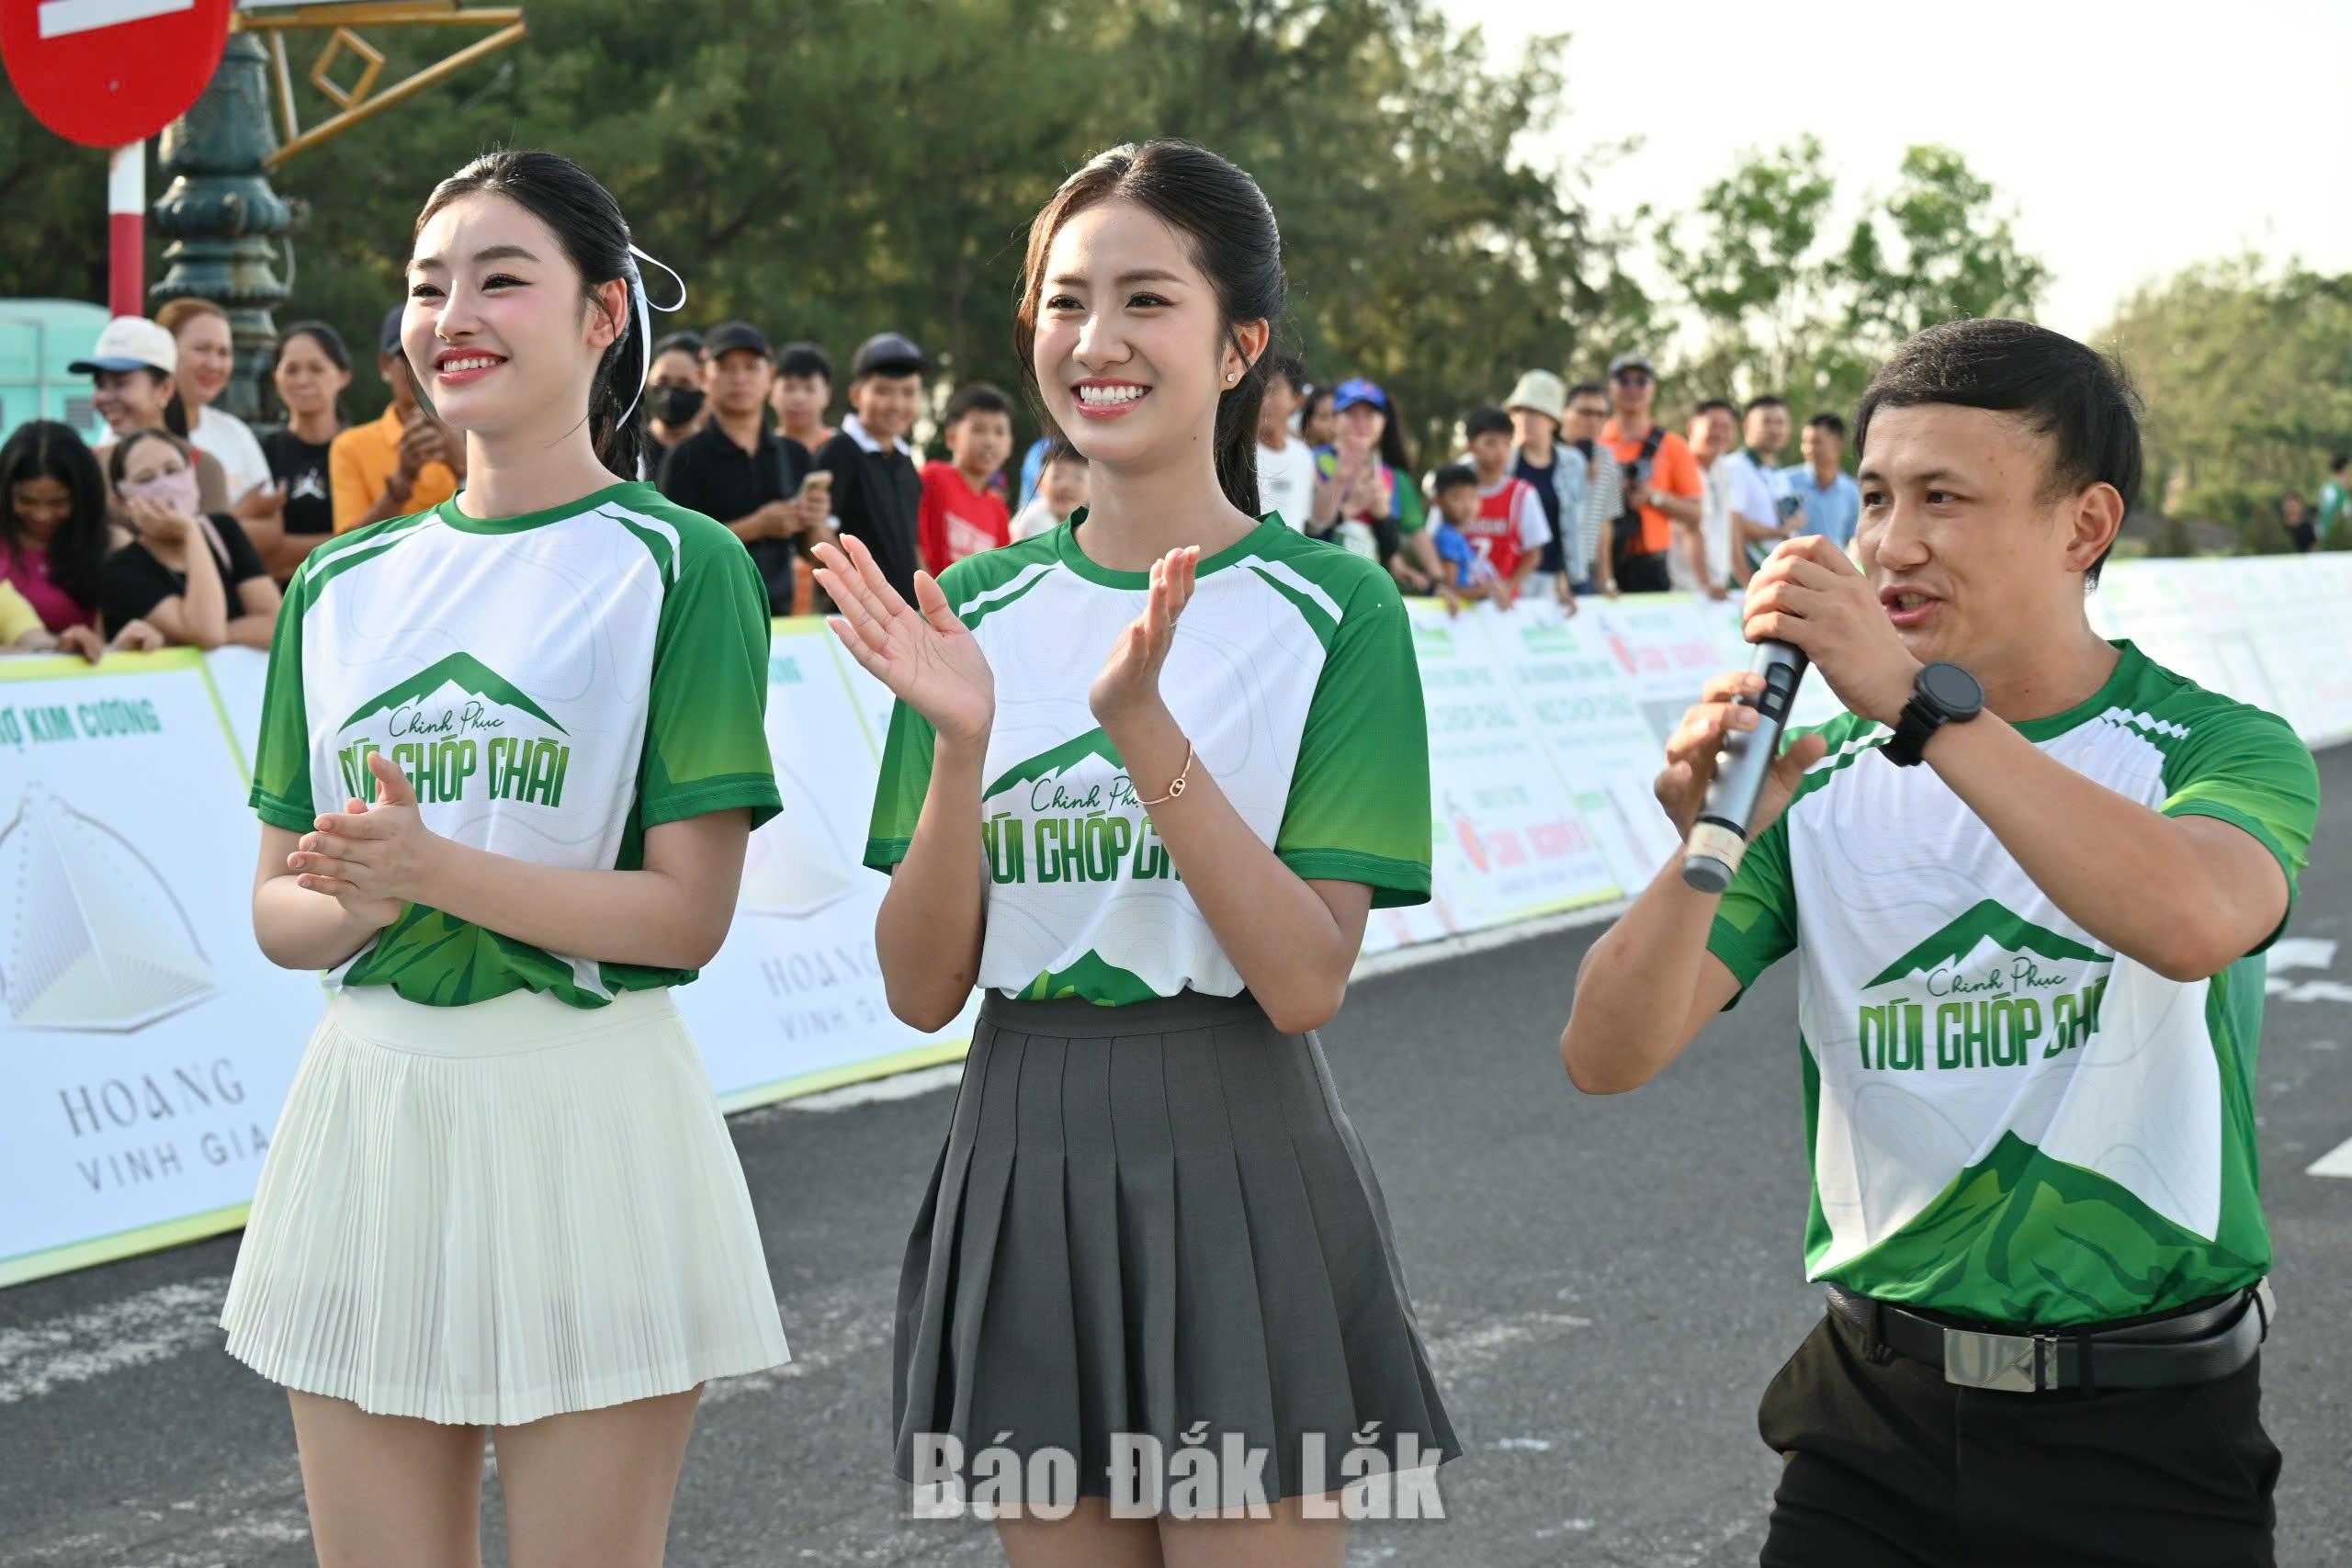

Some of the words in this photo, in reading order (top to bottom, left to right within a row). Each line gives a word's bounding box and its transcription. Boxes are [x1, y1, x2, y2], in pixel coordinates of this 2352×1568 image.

[23, 705, 78, 742] KIM
[460, 701, 504, 734] Phục
[1035, 810, 1131, 884] CHÓP
[2011, 956, 2067, 993] Phục
[1859, 997, 1925, 1071] NÚI
[1936, 991, 2041, 1070] CHÓP
[76, 1142, 183, 1194] VINH
[199, 1122, 272, 1168] GIA
